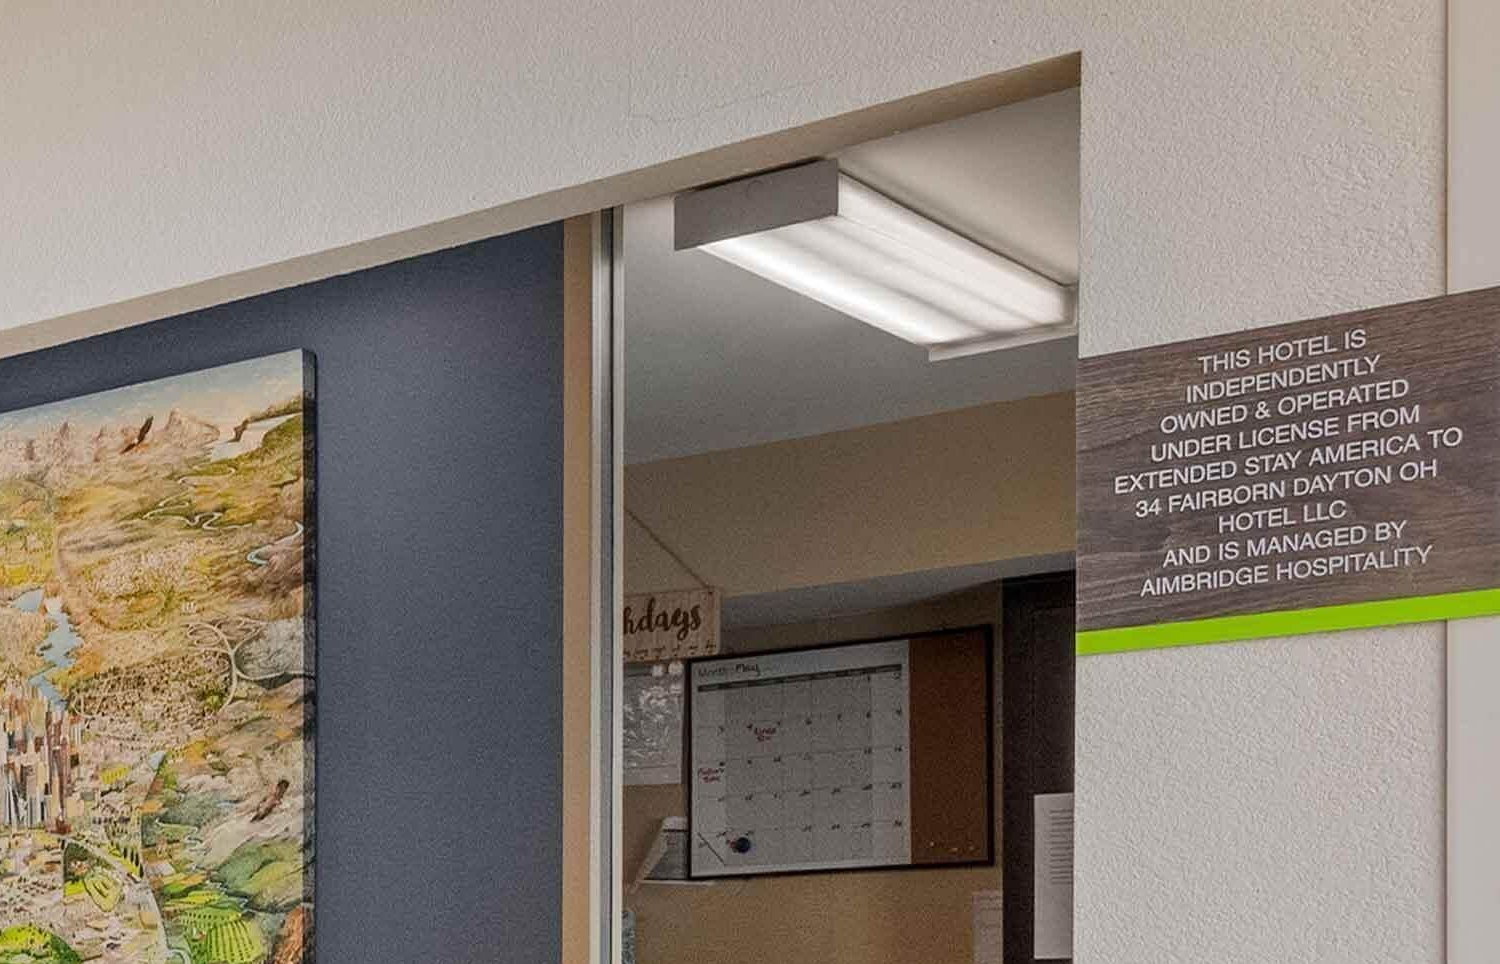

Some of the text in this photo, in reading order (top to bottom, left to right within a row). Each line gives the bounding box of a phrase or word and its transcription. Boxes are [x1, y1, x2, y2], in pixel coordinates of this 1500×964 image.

[1197, 329, 1366, 374] THIS HOTEL IS
[1187, 354, 1380, 403] INDEPENDENTLY
[1160, 379, 1409, 434] OWNED & OPERATED
[1151, 404, 1420, 462] UNDER LICENSE FROM
[1115, 427, 1463, 494] EXTENDED STAY AMERICA TO
[1135, 459, 1437, 517] 34 FAIRBORN DAYTON OH
[1219, 500, 1347, 533] HOTEL LLC
[1163, 520, 1407, 568] AND IS MANAGED BY
[1140, 545, 1432, 597] AIMBRIDGE HOSPITALITY
